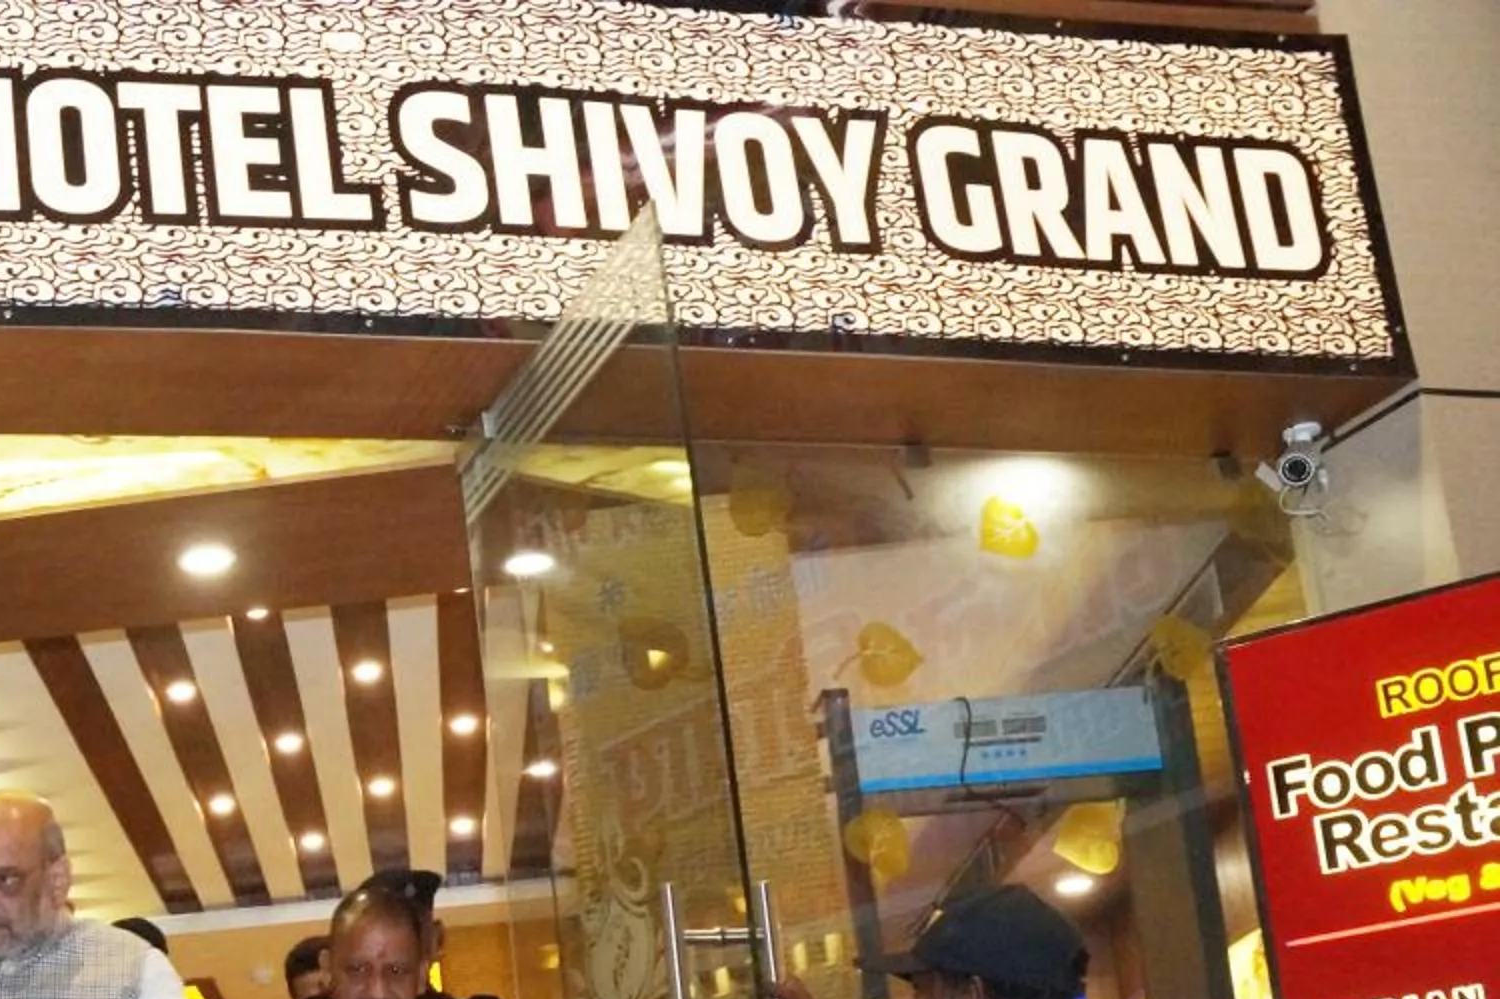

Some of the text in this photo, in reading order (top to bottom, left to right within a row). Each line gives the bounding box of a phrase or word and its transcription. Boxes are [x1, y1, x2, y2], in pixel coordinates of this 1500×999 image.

[393, 87, 881, 249] SHIVOY
[911, 124, 1326, 273] GRAND
[1266, 725, 1447, 820] Food
